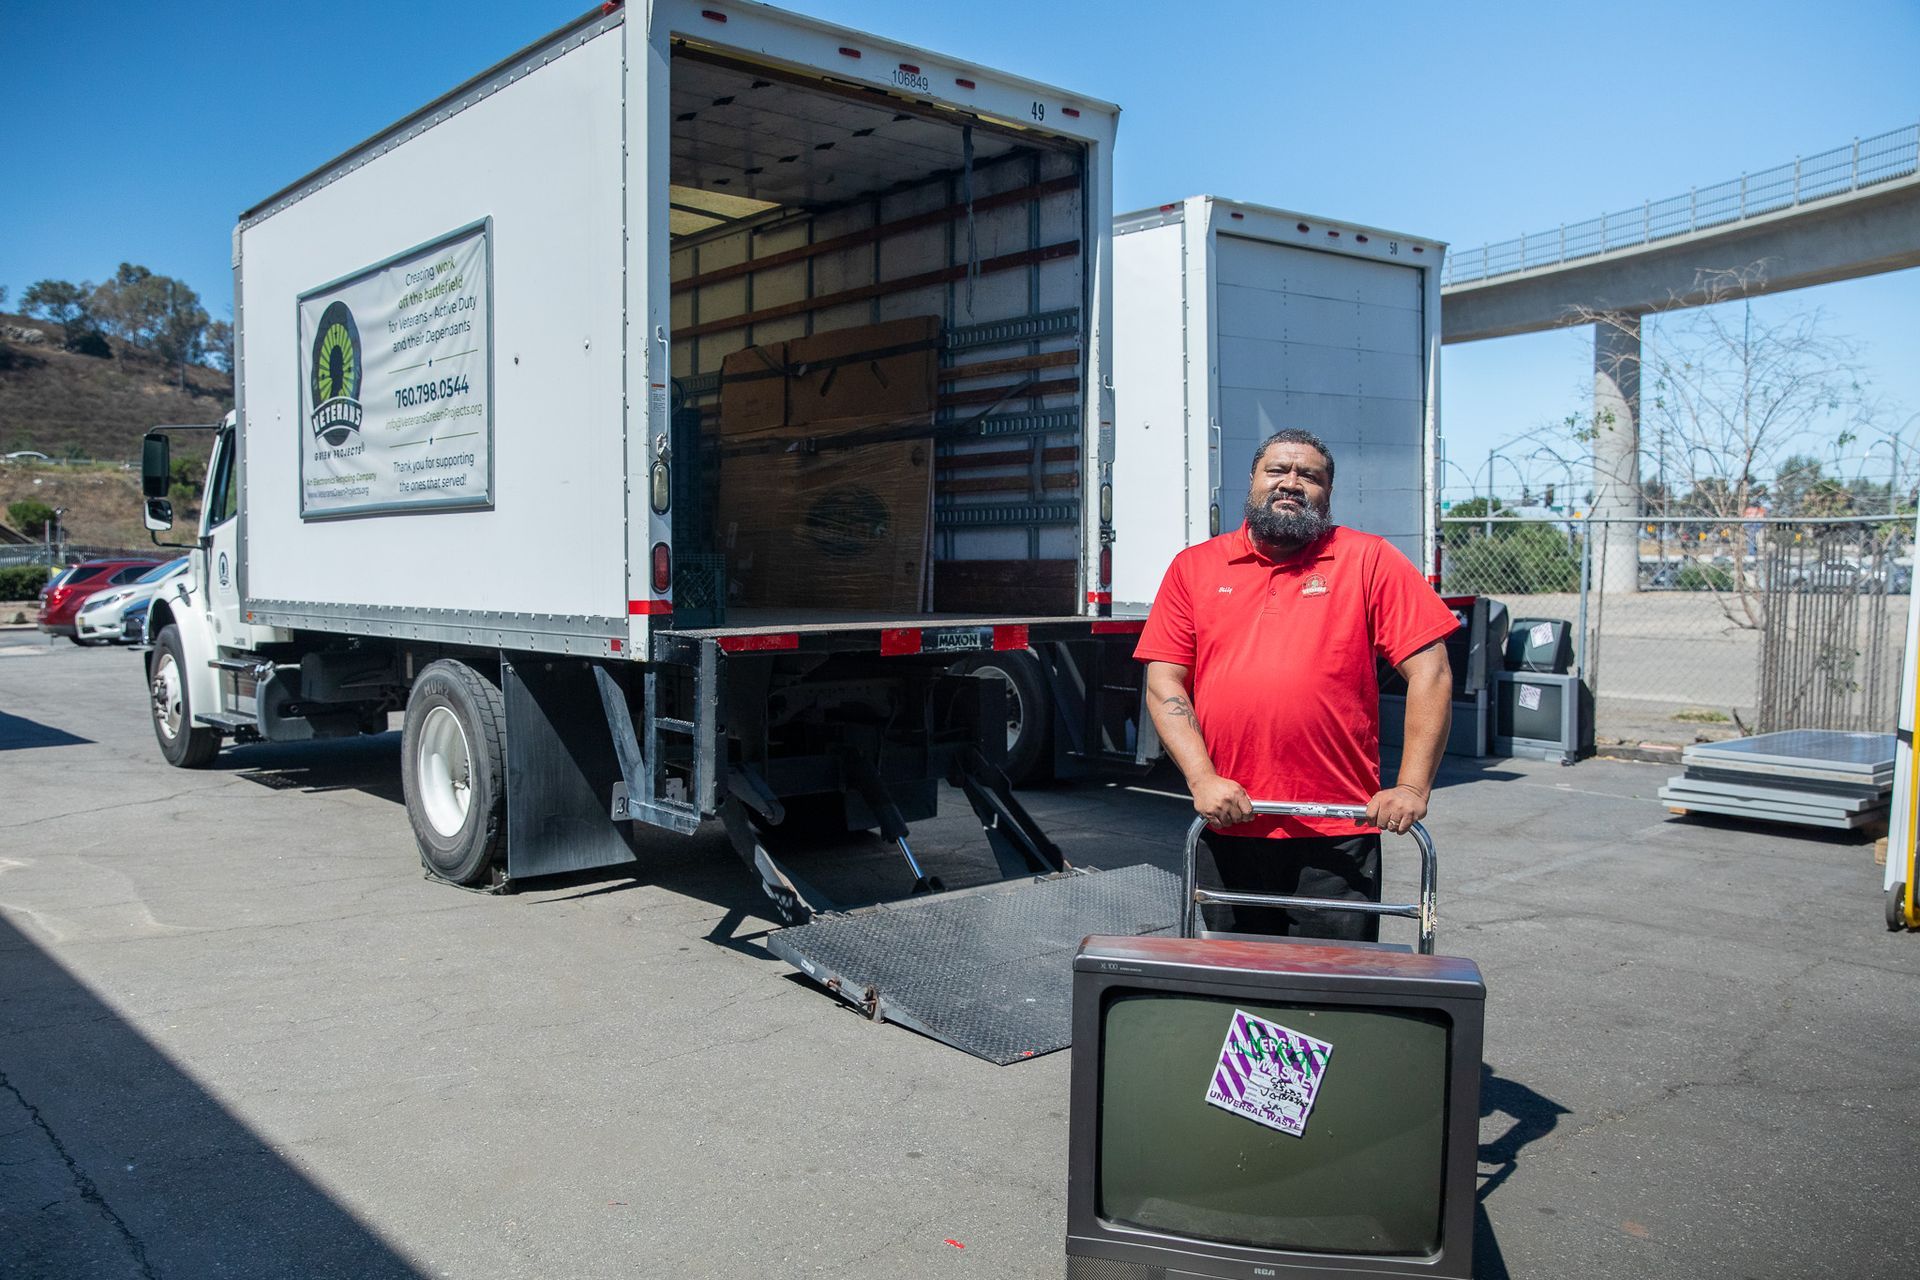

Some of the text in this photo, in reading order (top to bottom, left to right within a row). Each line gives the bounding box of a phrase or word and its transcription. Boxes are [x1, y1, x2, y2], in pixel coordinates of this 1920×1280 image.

[892, 70, 928, 91] 106849
[1031, 101, 1045, 121] 49
[405, 256, 456, 286] Creating work
[398, 274, 463, 309] off the battlefield
[388, 320, 398, 333] for
[399, 312, 428, 329] Veterans
[434, 301, 457, 319] Active
[458, 295, 477, 311] Duty
[393, 320, 471, 352] and their Dependants
[395, 374, 469, 408] 760.798.0544
[312, 403, 361, 433] VETERANS
[333, 446, 362, 459] PROJECTS
[393, 452, 475, 474] Thank you for supporting
[356, 472, 377, 482] Company
[399, 473, 467, 492] the ones that served!
[939, 634, 978, 647] MAXON
[1257, 1060, 1311, 1089] WASTE
[1209, 1090, 1263, 1117] UNIVERSAL
[1266, 1110, 1301, 1130] WASTE
[1254, 1268, 1275, 1276] RCA
